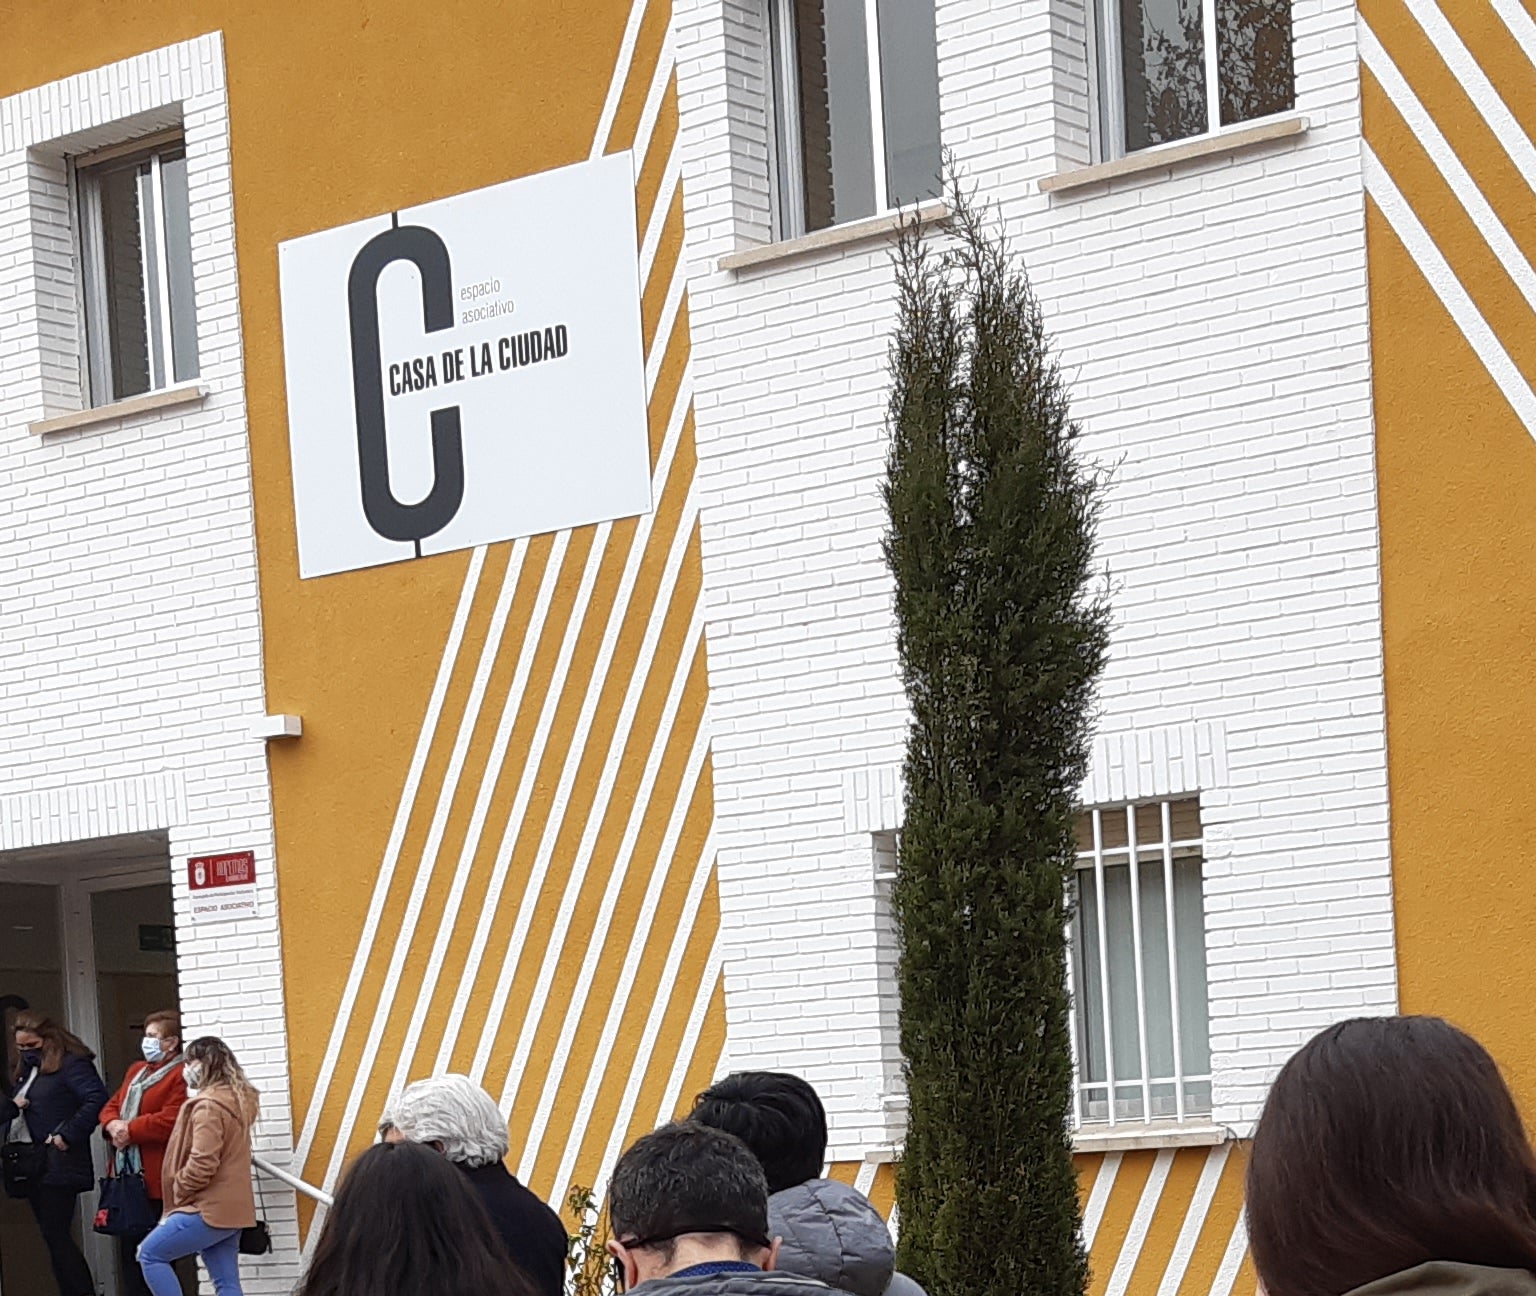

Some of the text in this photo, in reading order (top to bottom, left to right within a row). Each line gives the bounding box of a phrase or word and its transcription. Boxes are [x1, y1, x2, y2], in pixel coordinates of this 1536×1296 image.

[460, 276, 501, 301] espacio
[462, 299, 515, 324] asociativo
[389, 324, 568, 397] CASA DE LA CIUDAD
